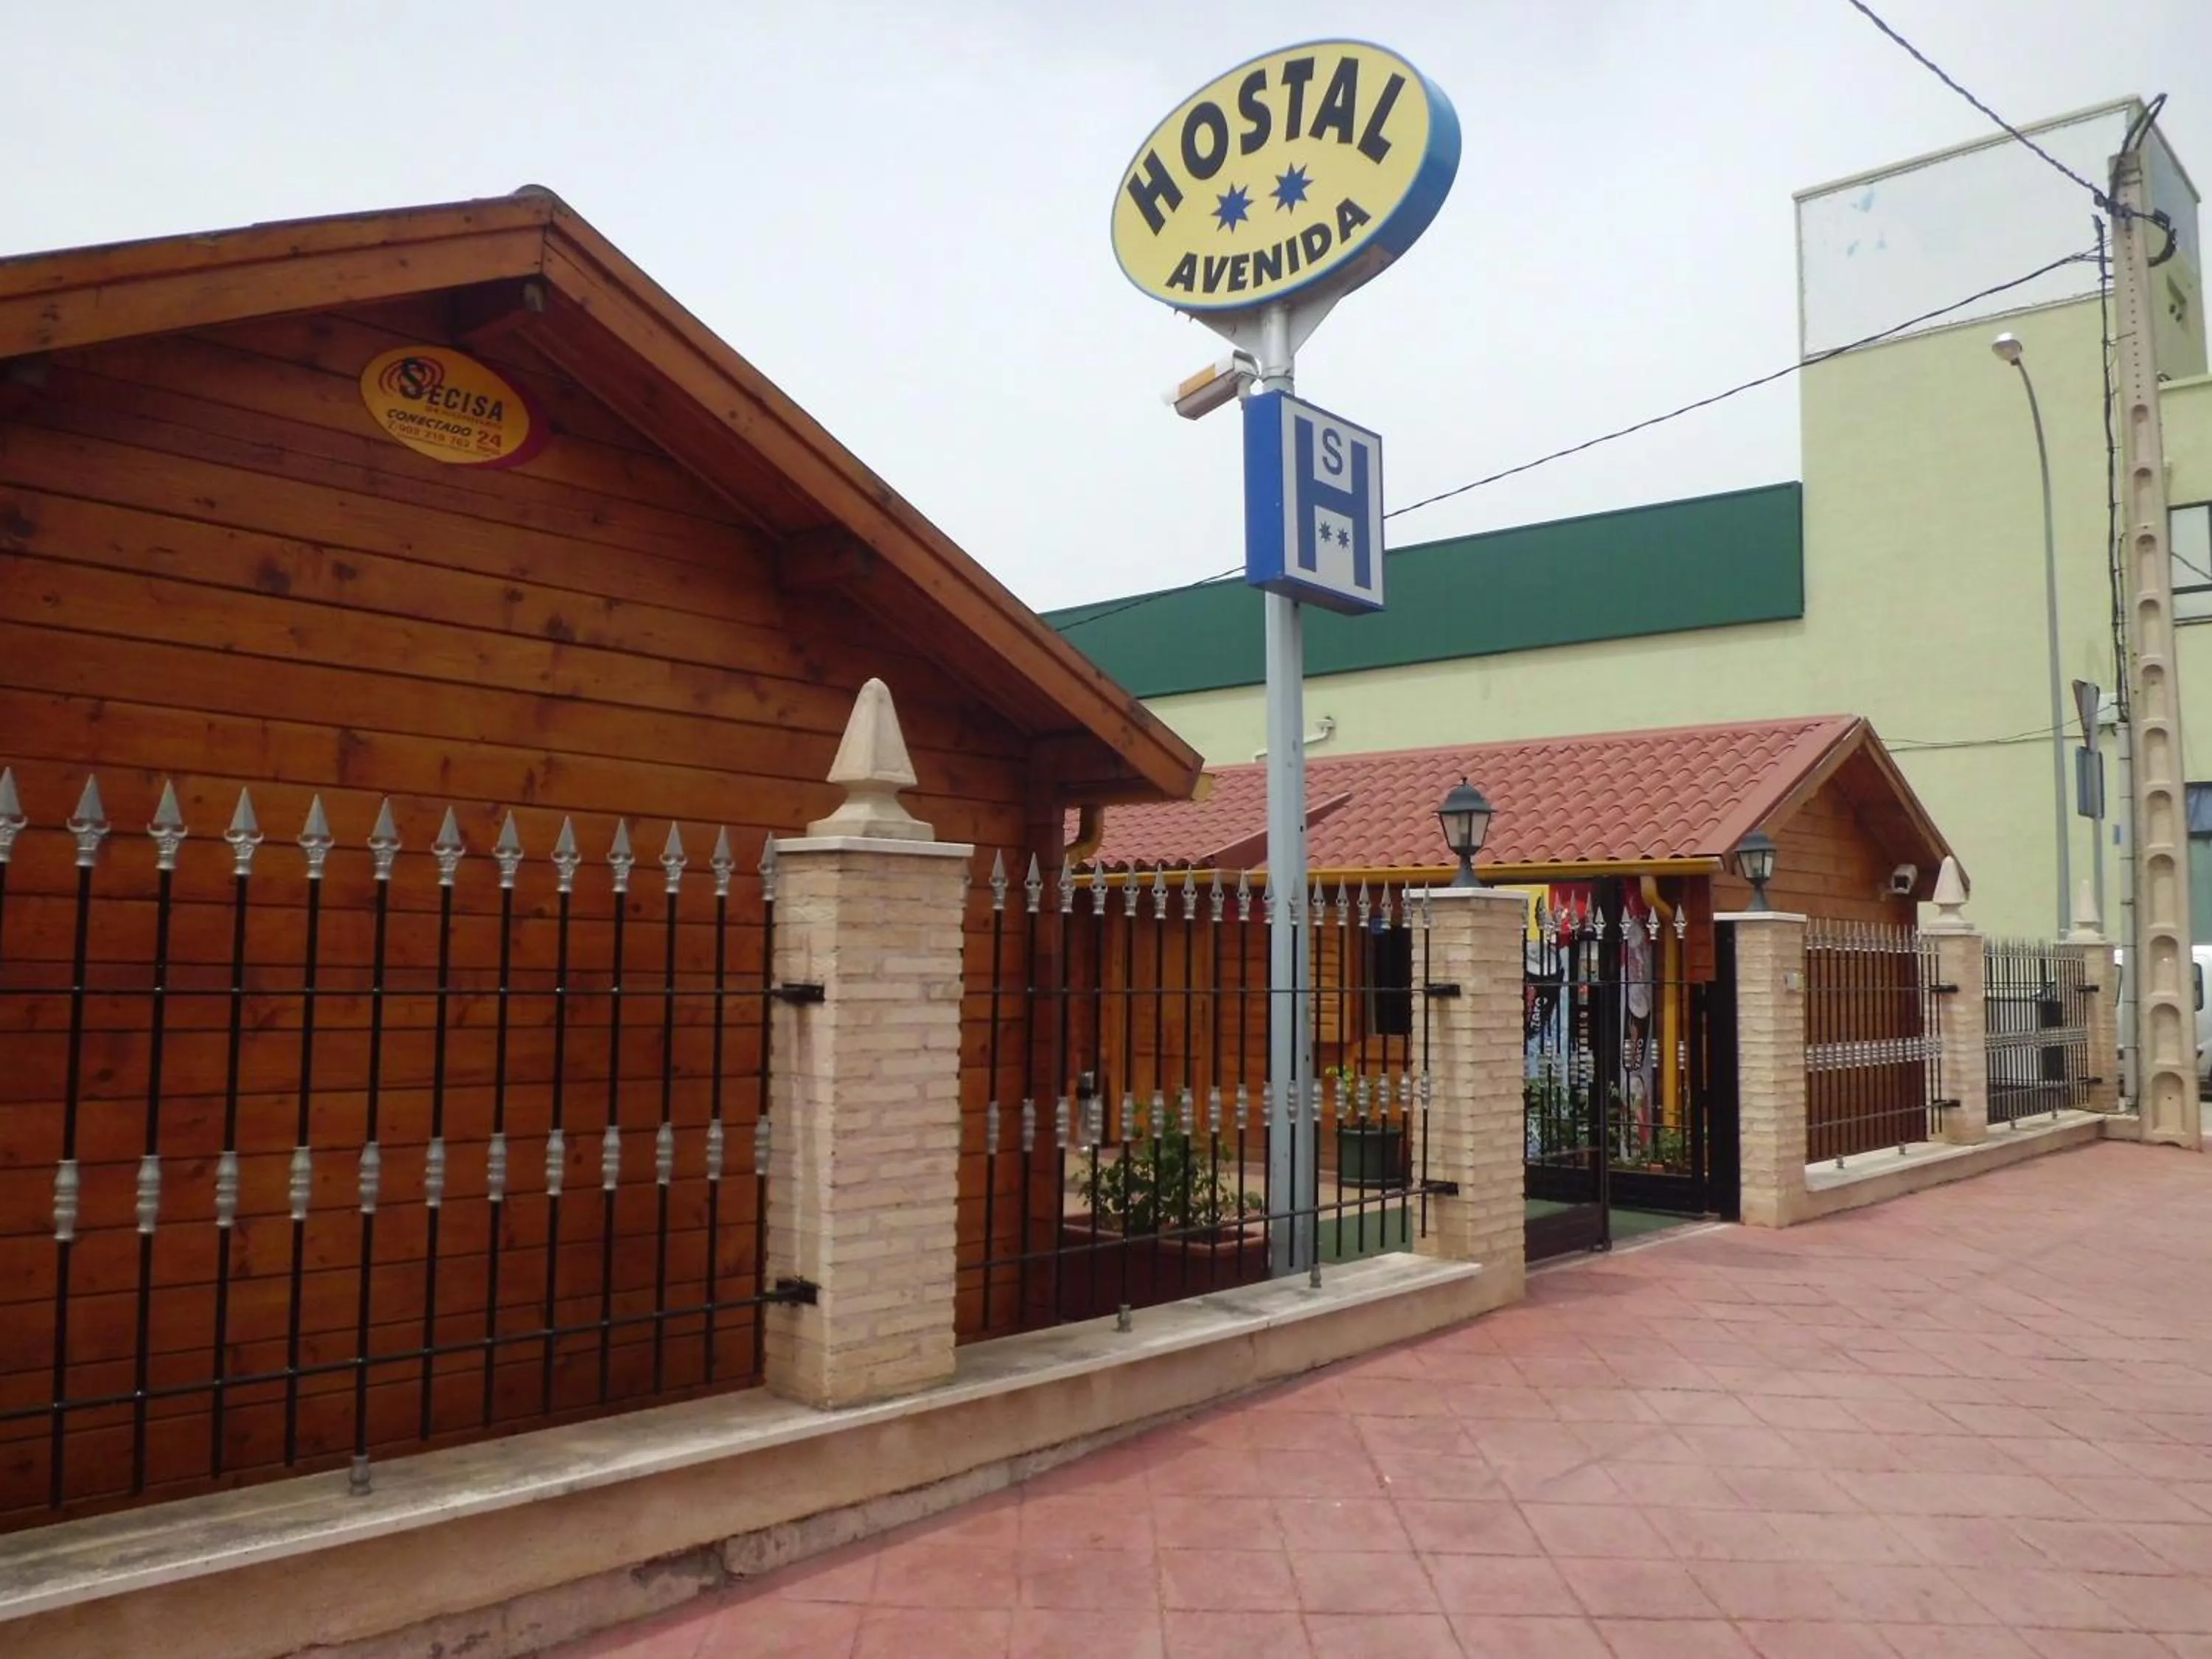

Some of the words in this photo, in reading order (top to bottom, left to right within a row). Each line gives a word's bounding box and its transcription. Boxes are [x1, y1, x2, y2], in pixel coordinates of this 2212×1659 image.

[1127, 56, 1406, 237] HOSTAL
[1164, 197, 1372, 294] AVENIDA
[386, 408, 472, 437] CONECTADO
[477, 431, 503, 449] 24
[399, 357, 504, 422] SECISA
[1322, 427, 1343, 476] S
[1294, 414, 1371, 591] H
